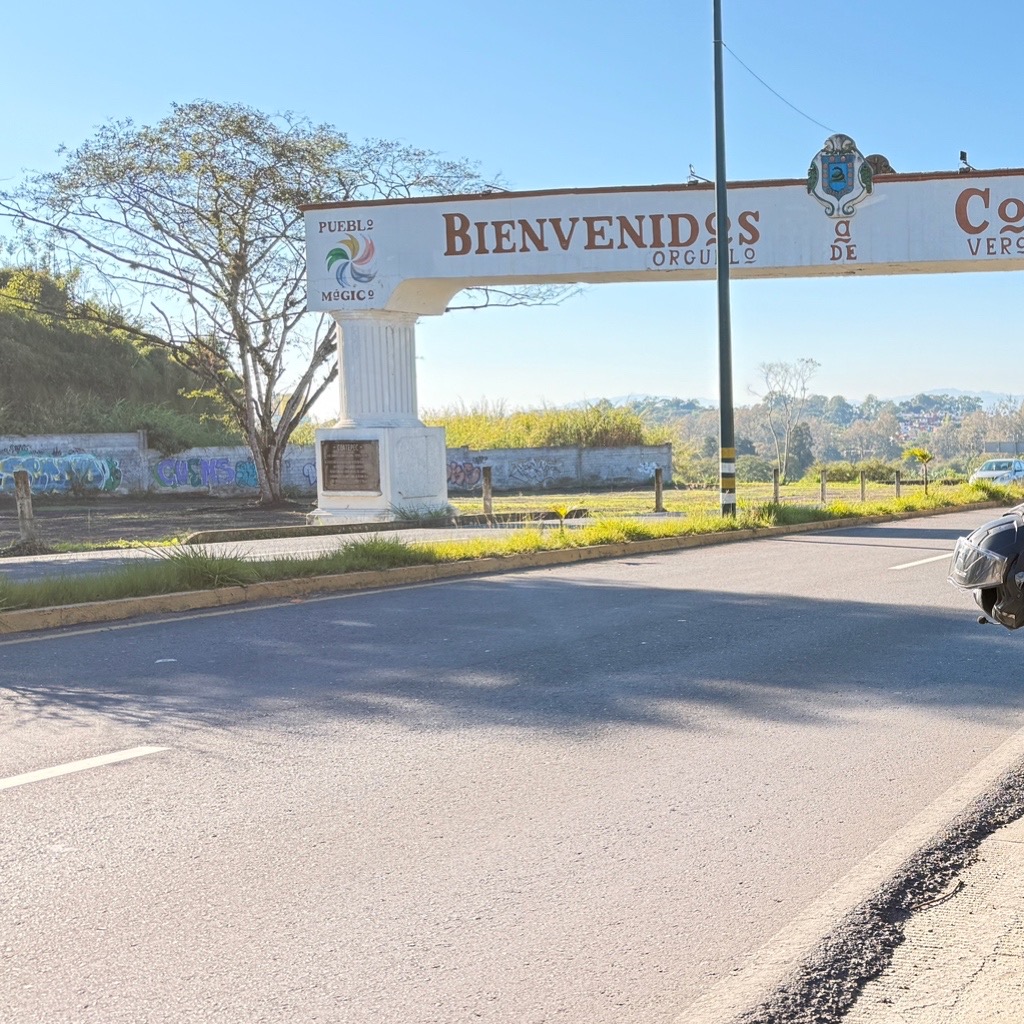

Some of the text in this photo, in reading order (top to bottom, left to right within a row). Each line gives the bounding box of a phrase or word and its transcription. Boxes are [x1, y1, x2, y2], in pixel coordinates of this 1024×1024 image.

[319, 219, 374, 233] PUEBLO
[442, 211, 760, 256] BIENVENIDOS
[653, 247, 757, 267] ORGULO
[830, 244, 857, 261] DE
